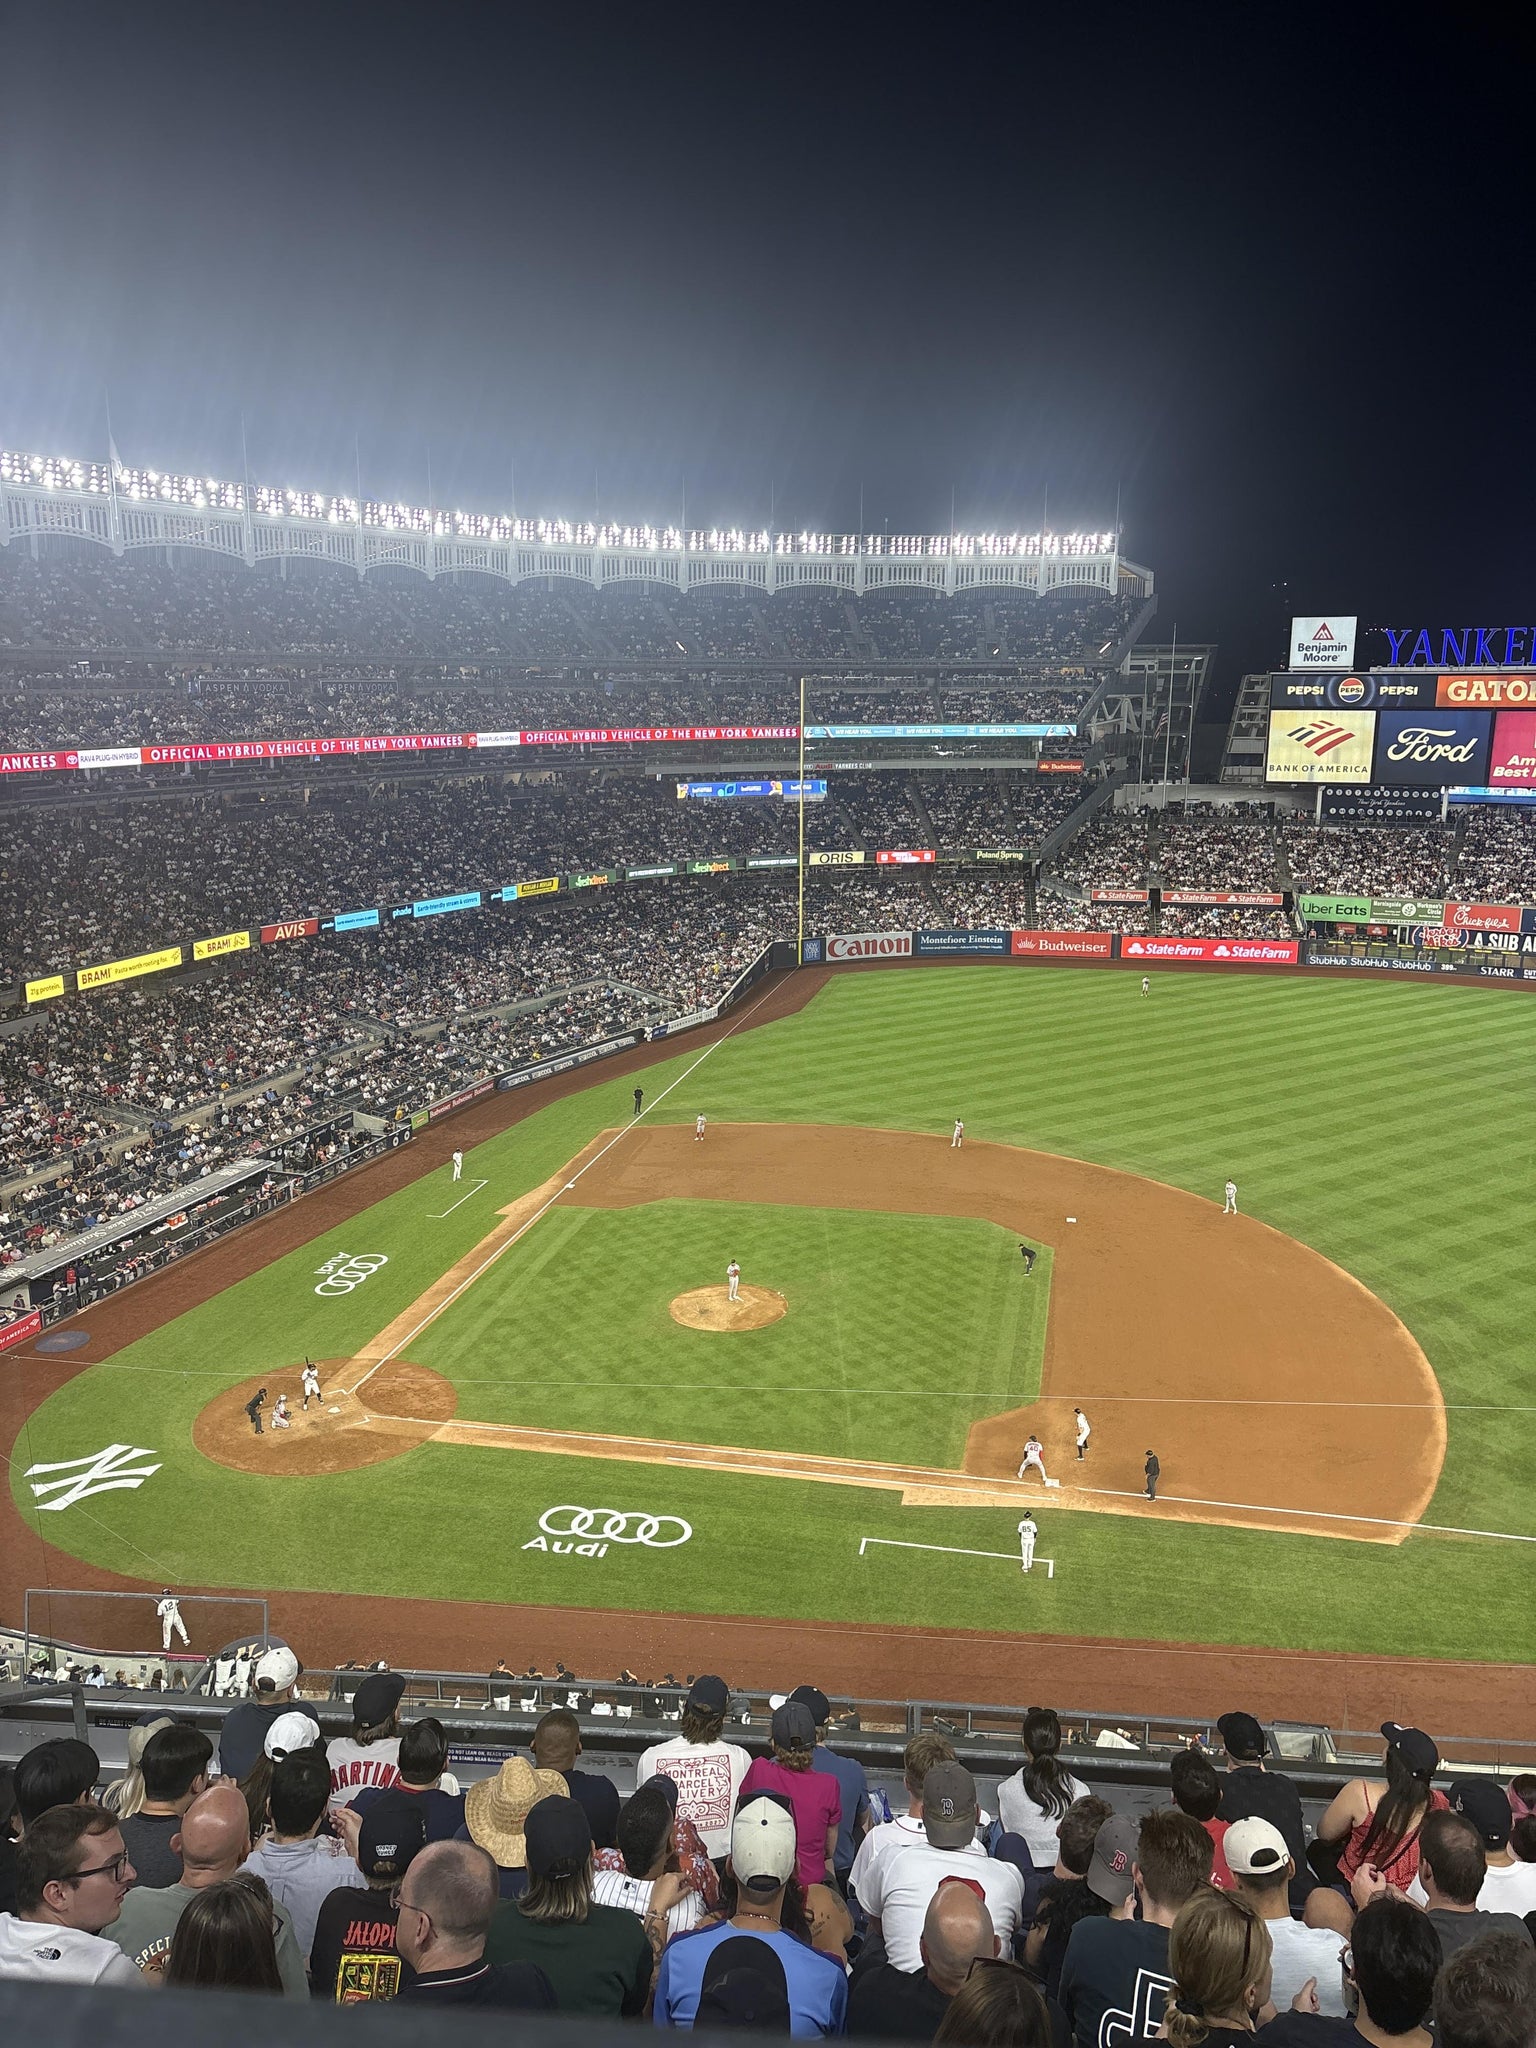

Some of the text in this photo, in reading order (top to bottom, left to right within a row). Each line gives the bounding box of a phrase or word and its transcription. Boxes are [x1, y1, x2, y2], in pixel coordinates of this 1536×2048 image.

[1297, 643, 1348, 654] Benjamin
[1303, 652, 1339, 662] Moore
[205, 683, 284, 692] ASPEN VODKA
[1287, 686, 1324, 696] PEPSI
[1379, 686, 1418, 696] PEPSI
[526, 728, 798, 743] OFFICIAL HYBRID VEHICLE OF THE NEW YORK YANKEES
[150, 735, 463, 761] OFFICIAL HYBRID VEHICLE OF THE NEW YORK YANKEES
[1387, 727, 1478, 763] Ford
[0, 755, 57, 770] ANKEES
[118, 752, 138, 761] HYBRID
[1269, 765, 1368, 773] BANK OF AMERICA
[1493, 766, 1530, 777] Best
[819, 852, 854, 864] ORIS
[976, 851, 1023, 860] Poland Spring
[692, 862, 729, 873] freshdirect
[1302, 901, 1367, 916] Uber Eats
[274, 923, 306, 941] AVIS
[920, 934, 1003, 944] Montefiore Einstein
[207, 938, 232, 953] BRAMI
[828, 937, 910, 958] Canon
[1474, 932, 1484, 948] A
[1488, 932, 1519, 951] SUB
[1309, 956, 1432, 971] StubHub StubHub StubHub
[81, 968, 111, 985] BRAMI
[1480, 966, 1515, 977] STARR
[106, 1206, 147, 1230] Yankee
[55, 1228, 107, 1253] Stadium
[313, 1251, 353, 1275] Audi
[6, 1325, 30, 1341] AMERICA
[520, 1535, 609, 1558] Audi
[164, 1601, 174, 1612] 12
[664, 1767, 724, 1779] MONTREAL
[679, 1787, 724, 1799] LIVERY
[941, 1798, 955, 1818] B
[1110, 1849, 1128, 1872] B
